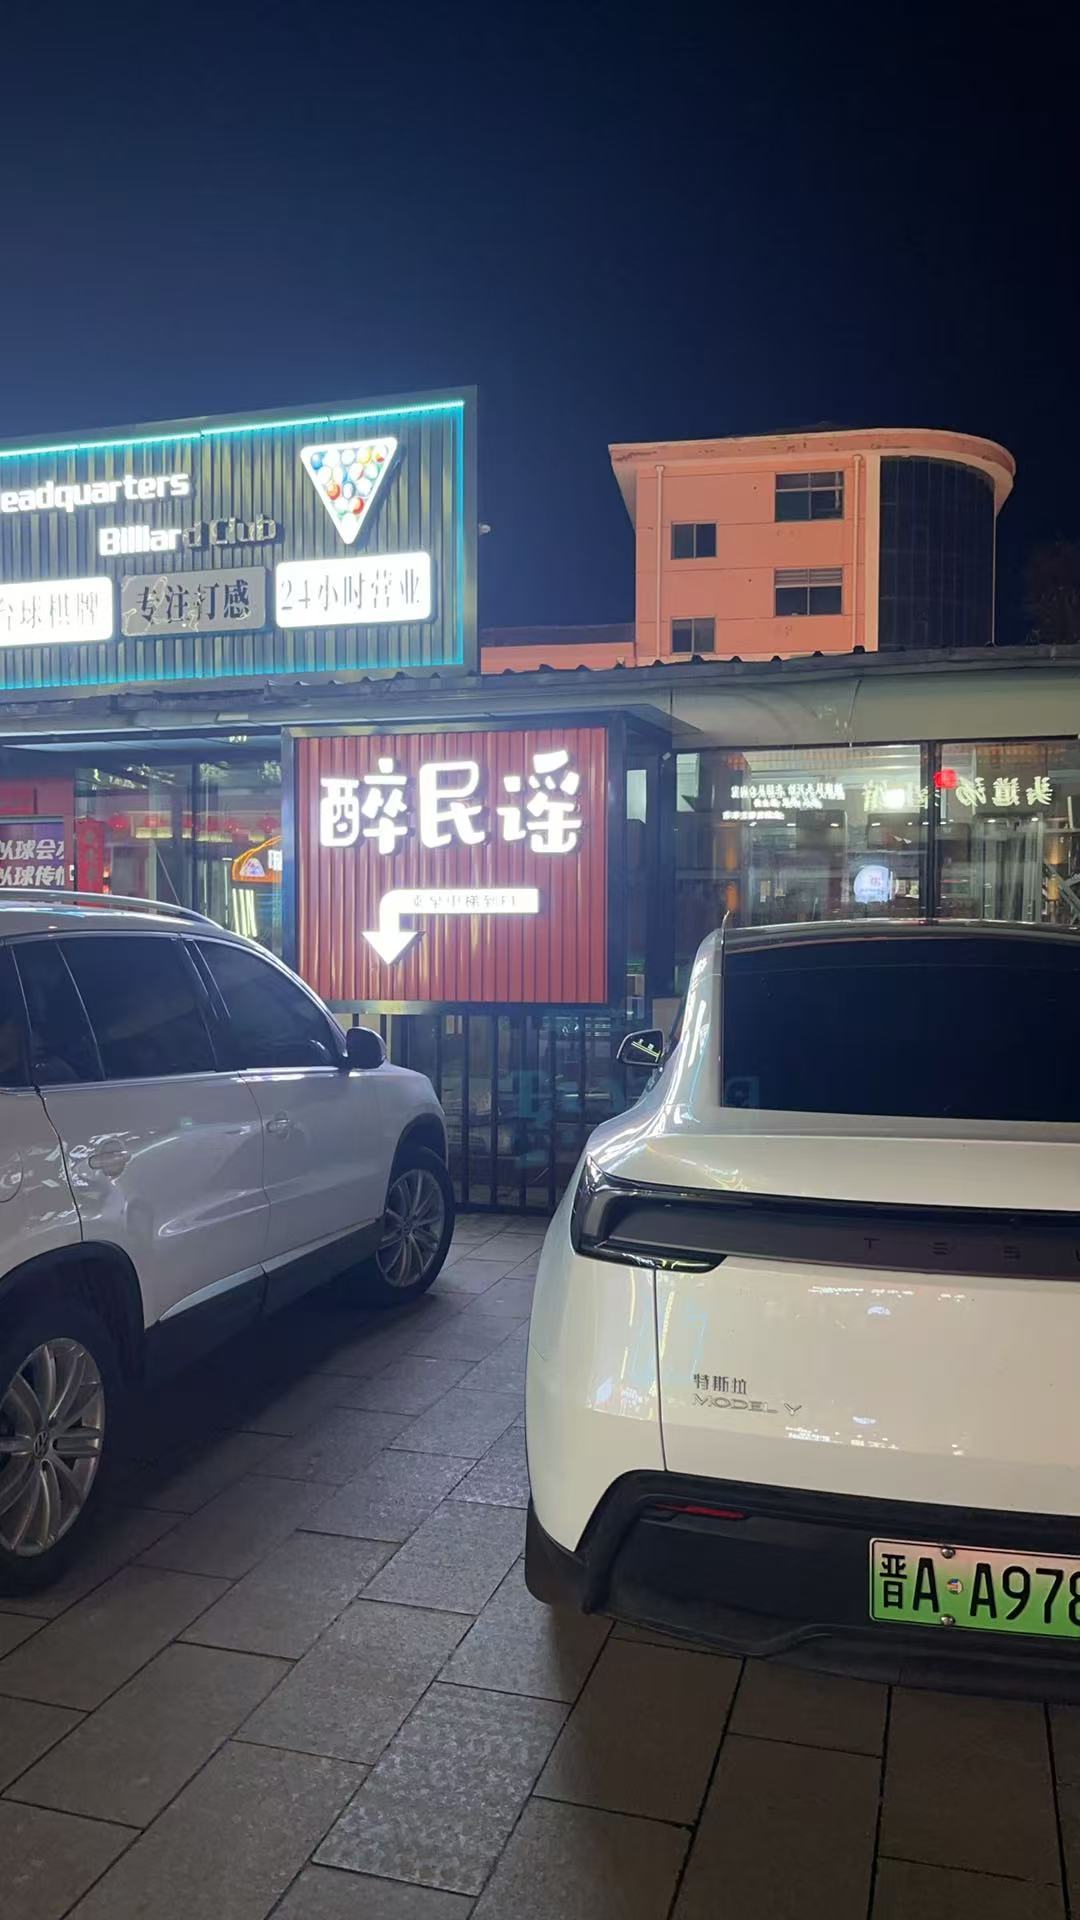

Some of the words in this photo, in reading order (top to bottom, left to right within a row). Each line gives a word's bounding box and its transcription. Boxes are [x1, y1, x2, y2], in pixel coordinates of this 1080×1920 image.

[99, 521, 202, 556] Billiard
[208, 515, 277, 546] Club
[280, 568, 422, 612] 24小时营业
[320, 750, 582, 855] 醉民谣
[693, 1373, 747, 1395] 特斯拉
[693, 1393, 778, 1414] MODEL
[783, 1402, 802, 1416] Y
